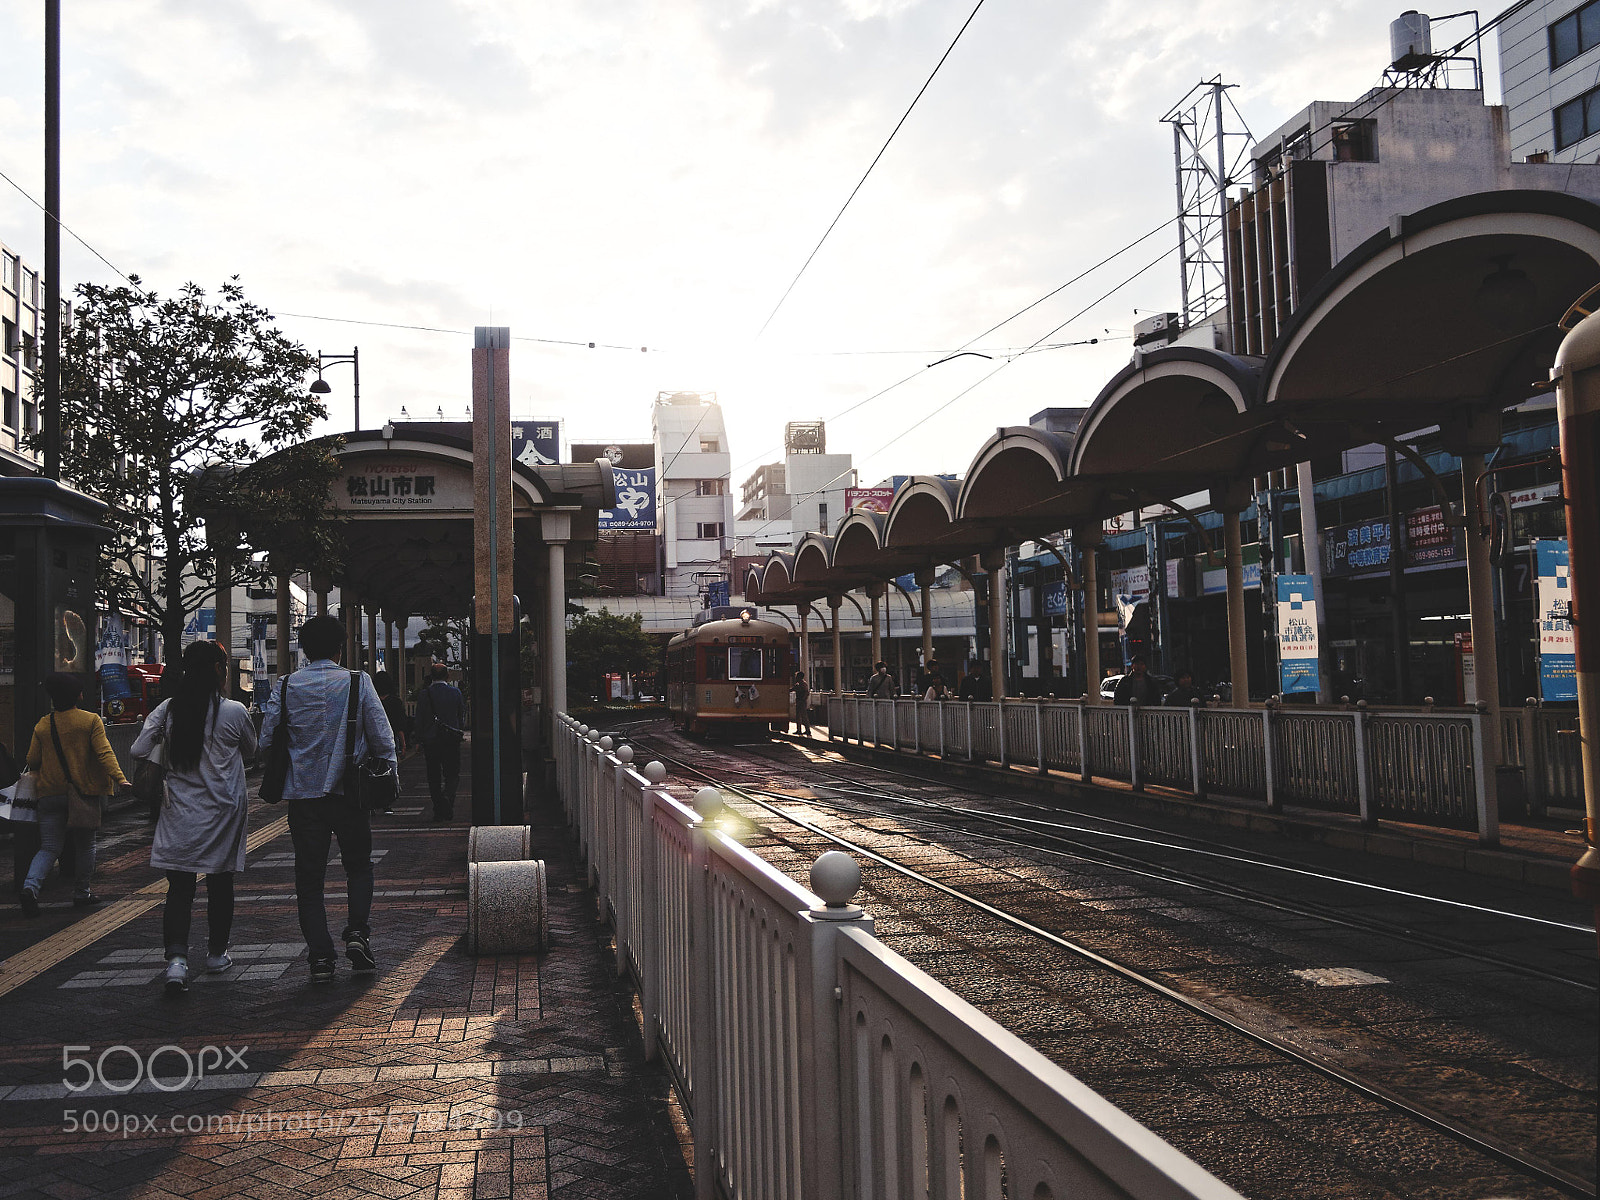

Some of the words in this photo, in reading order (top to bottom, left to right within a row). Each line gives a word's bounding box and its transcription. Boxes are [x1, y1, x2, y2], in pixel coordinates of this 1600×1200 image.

[364, 463, 418, 473] IYOTETSU
[347, 475, 435, 496] 松山市駅
[350, 497, 391, 506] Matsuyama
[392, 497, 406, 506] City
[407, 497, 432, 505] Station
[1347, 544, 1391, 568] 中等教育学
[1288, 617, 1308, 626] 松山
[1283, 625, 1313, 635] 市議会
